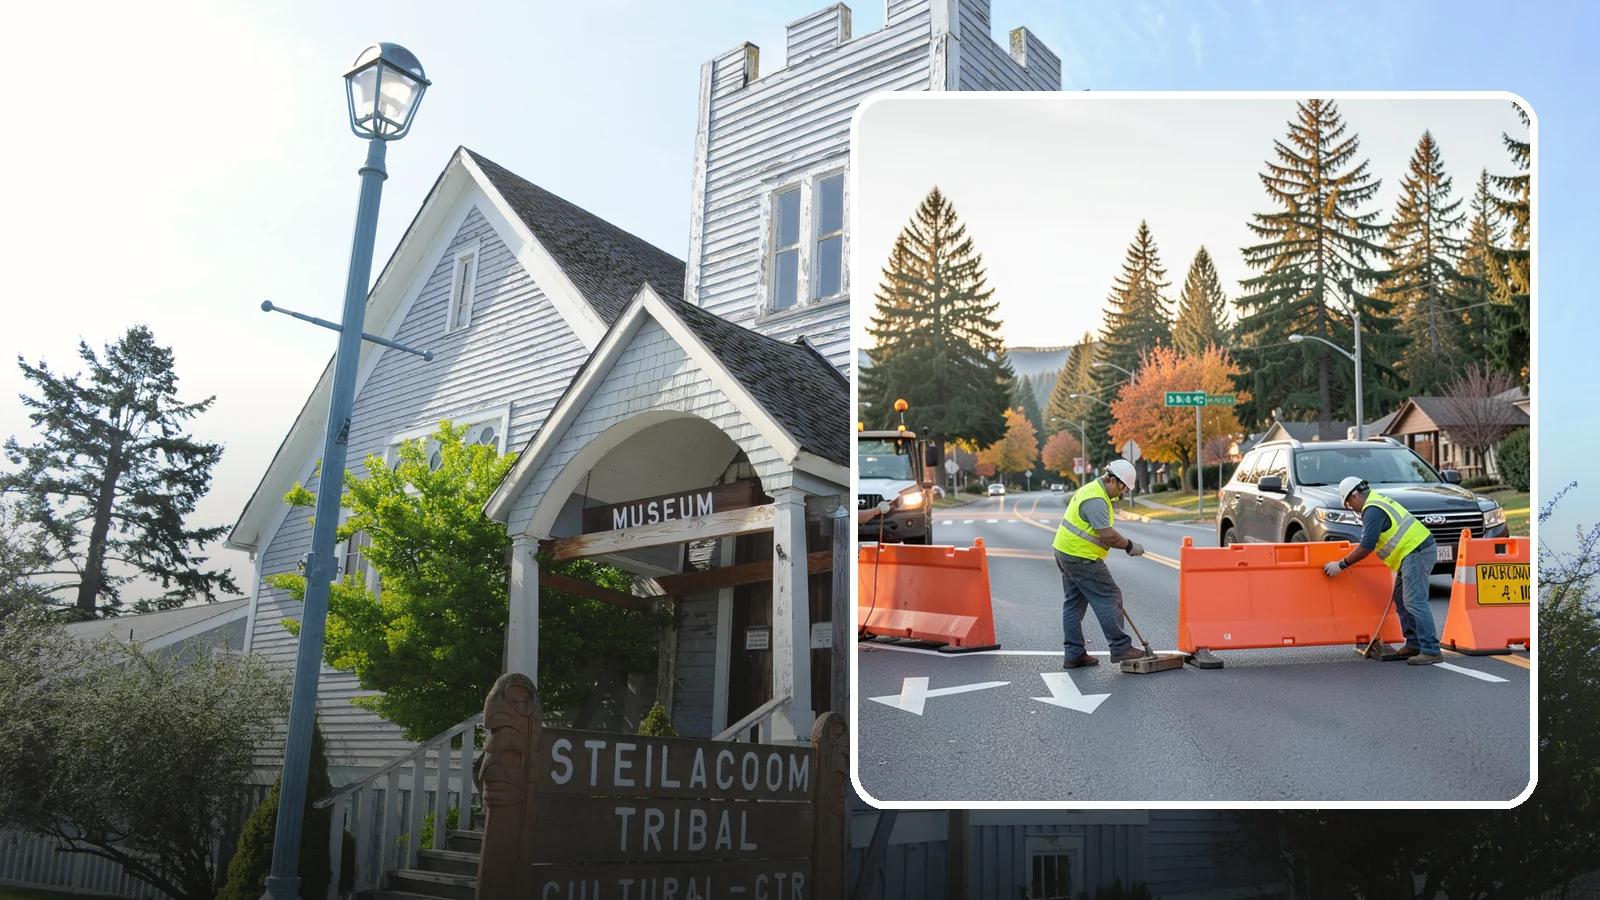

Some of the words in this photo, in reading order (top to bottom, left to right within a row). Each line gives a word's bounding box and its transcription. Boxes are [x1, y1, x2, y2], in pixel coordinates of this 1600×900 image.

[612, 491, 714, 531] MUSEUM
[550, 738, 810, 793] STEILACOOM
[614, 806, 758, 852] TRIBAL
